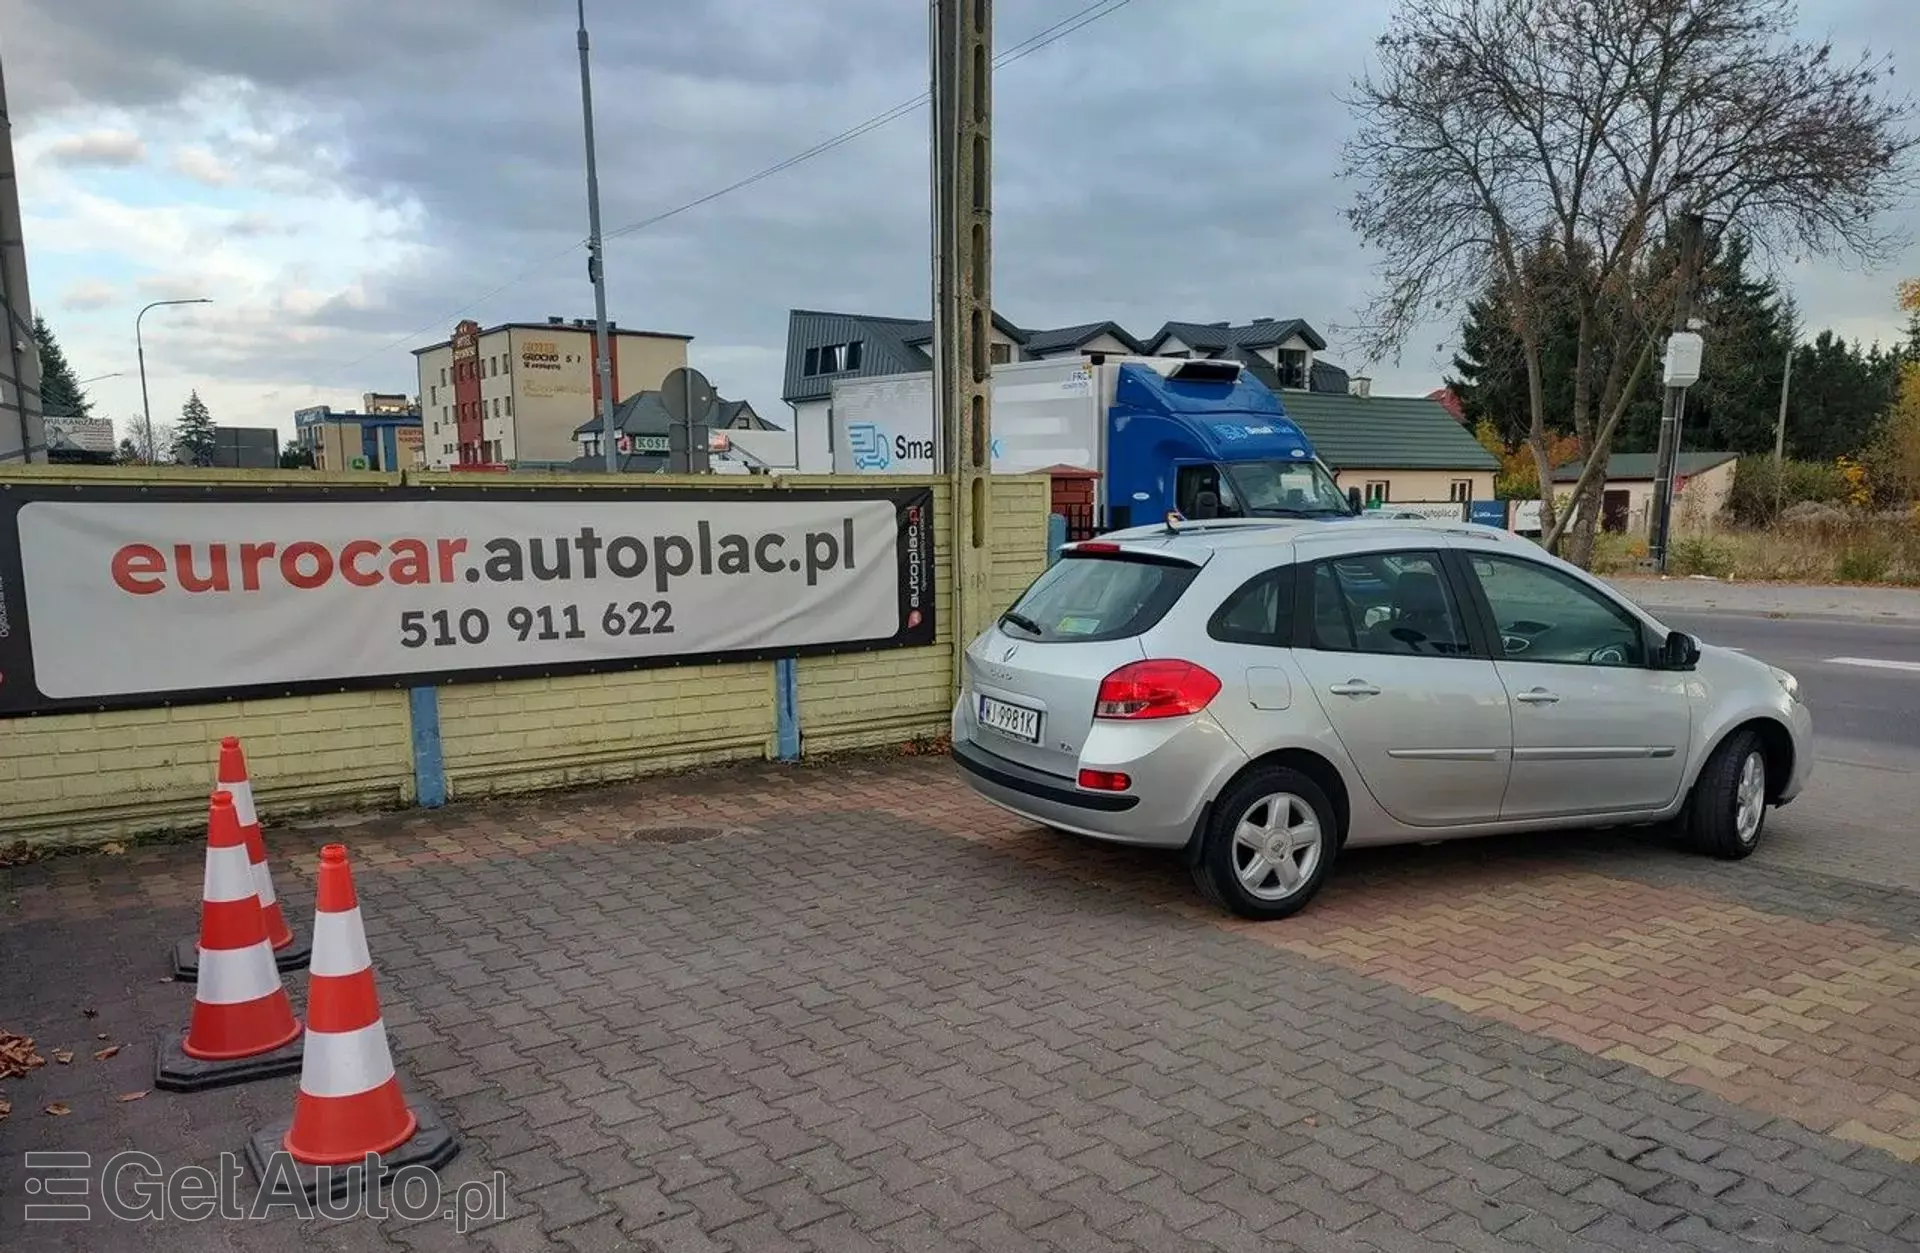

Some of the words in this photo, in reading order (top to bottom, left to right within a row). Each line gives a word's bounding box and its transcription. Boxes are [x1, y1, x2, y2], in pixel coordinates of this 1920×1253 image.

[111, 518, 855, 595] eurocar.autoplac.pl
[400, 608, 490, 648] 510
[507, 604, 586, 642] 911
[601, 600, 675, 637] 622
